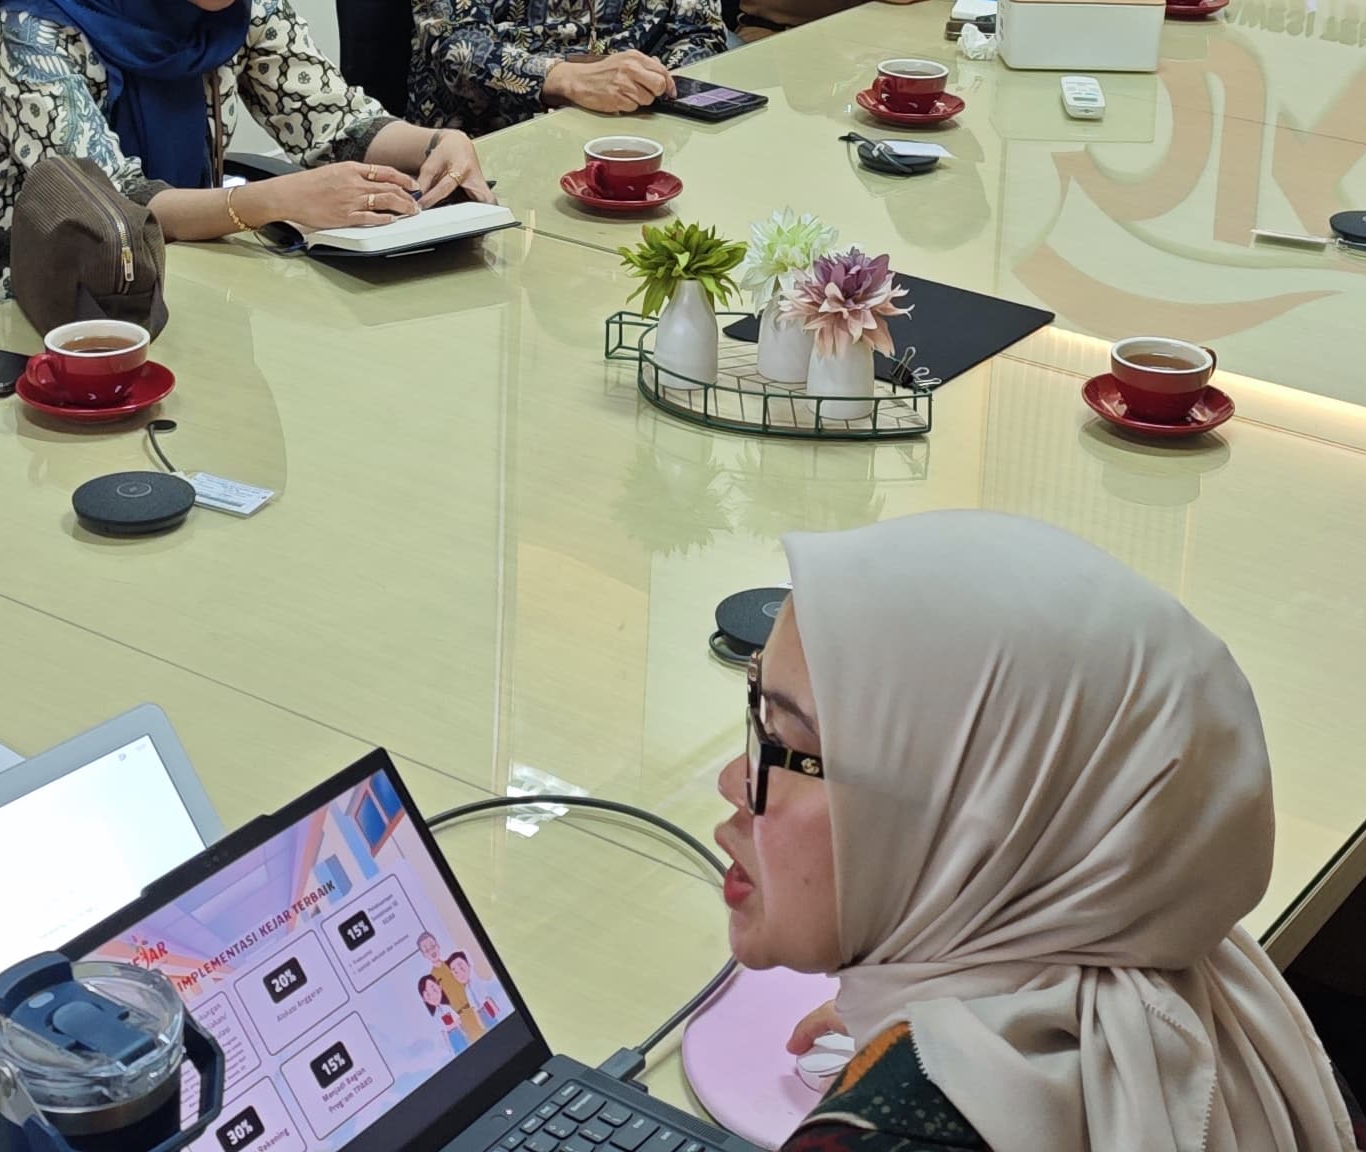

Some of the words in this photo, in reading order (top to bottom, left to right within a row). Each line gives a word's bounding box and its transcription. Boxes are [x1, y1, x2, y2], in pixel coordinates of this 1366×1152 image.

[177, 932, 259, 993] IMPLEMENTASI
[258, 909, 293, 938] KEJAR
[291, 879, 336, 915] TERBAIK
[346, 919, 370, 942] 15%
[271, 967, 297, 994] 20%
[320, 1051, 346, 1077] 15%
[226, 1118, 255, 1146] 30%
